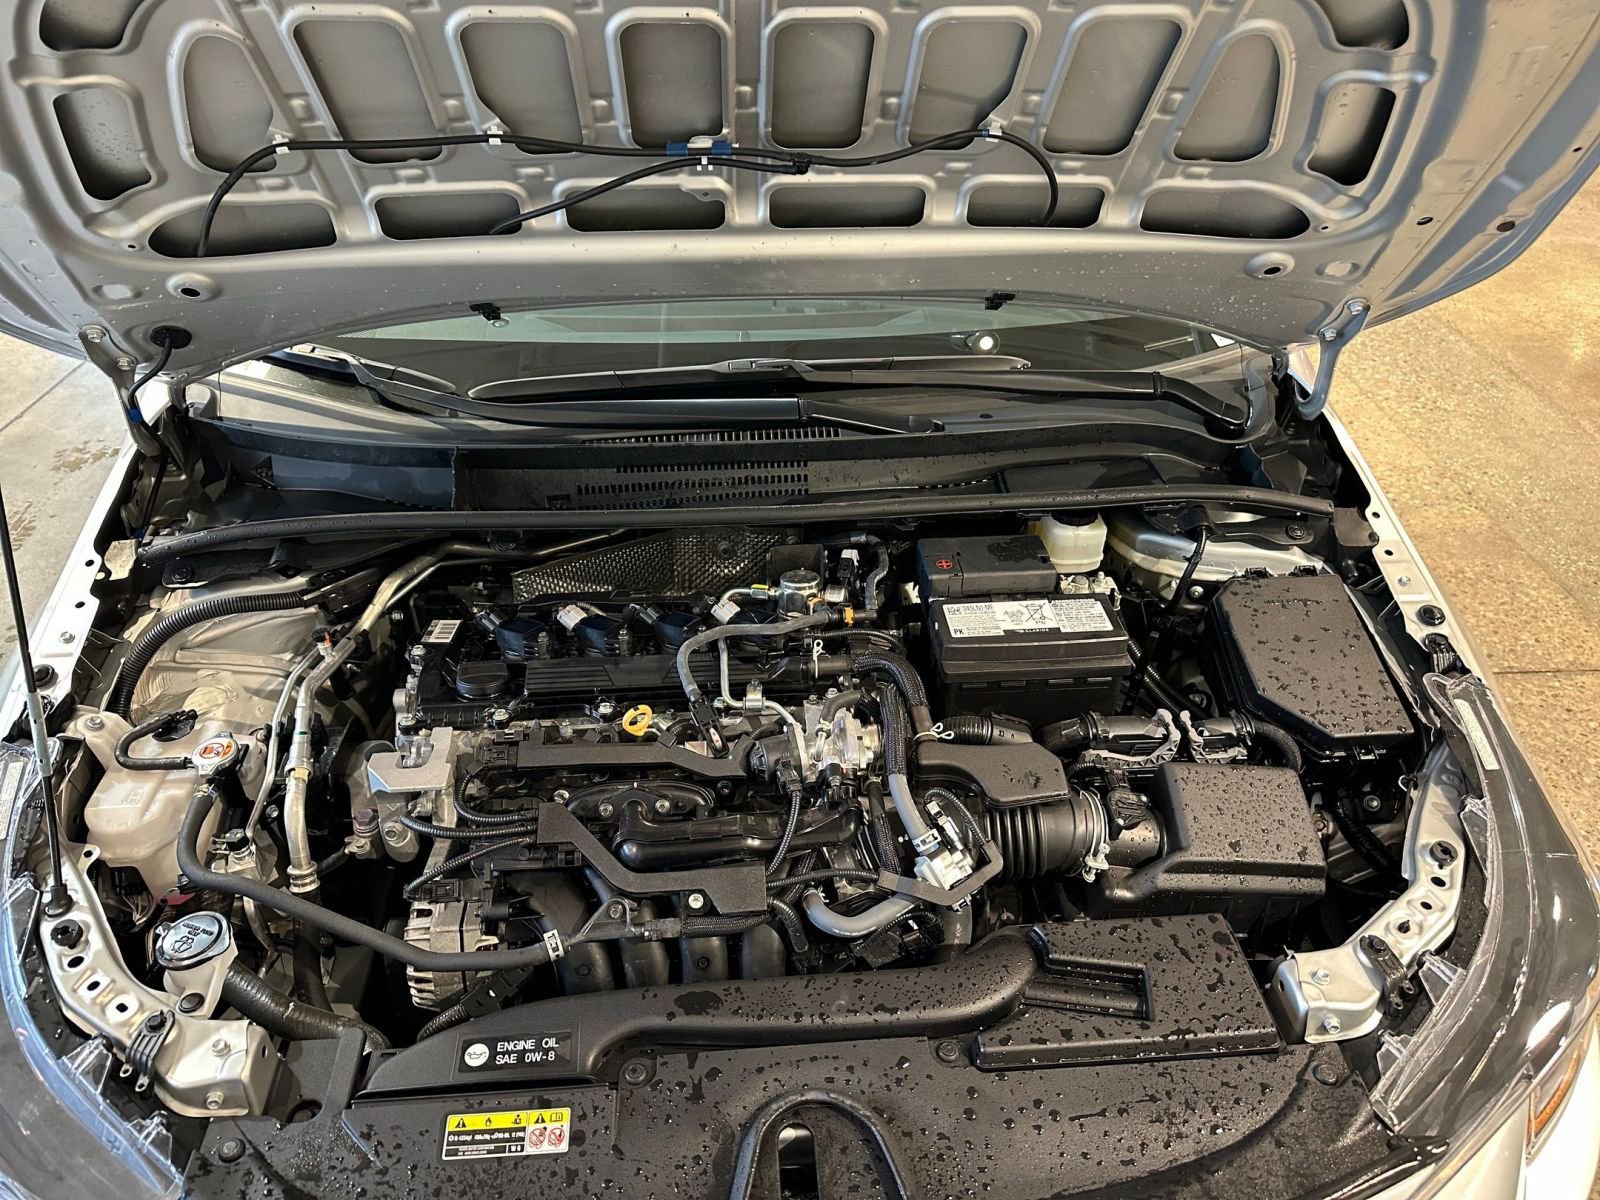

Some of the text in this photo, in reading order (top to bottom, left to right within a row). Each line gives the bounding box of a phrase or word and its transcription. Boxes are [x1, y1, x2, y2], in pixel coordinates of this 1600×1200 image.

[496, 1037, 559, 1051] ENGINE OIL
[495, 1051, 555, 1064] SAE 0W-8
